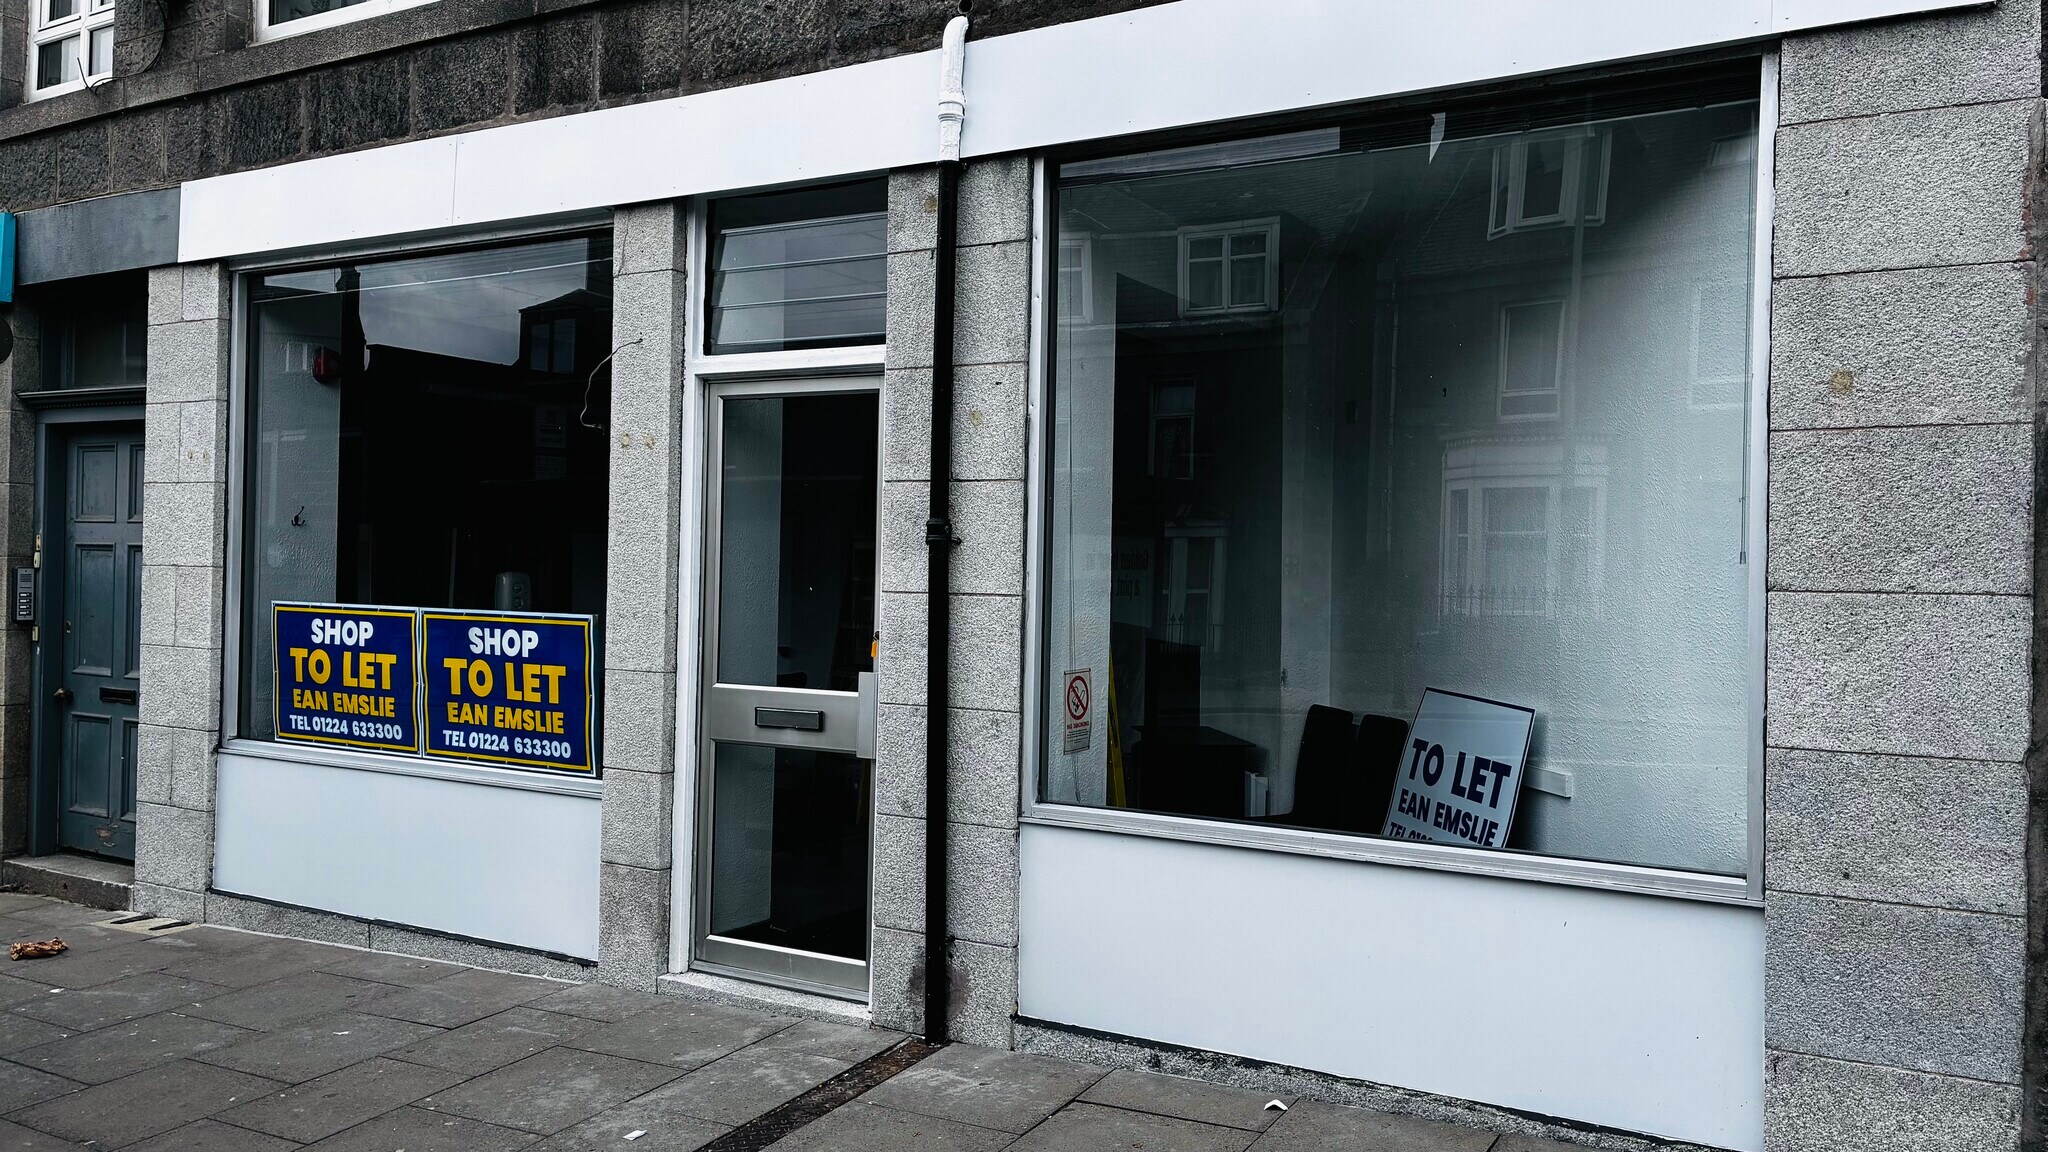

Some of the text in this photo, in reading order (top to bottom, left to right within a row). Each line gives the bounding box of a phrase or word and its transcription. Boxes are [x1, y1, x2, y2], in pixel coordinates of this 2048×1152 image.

[311, 618, 374, 647] SHOP
[468, 627, 539, 658] SHOP
[290, 647, 397, 690] TO LET
[443, 657, 566, 704] TO LET
[293, 688, 395, 718] EAN EMSLIE
[447, 702, 564, 734] EAN EMSLIE
[289, 714, 403, 740] TEL 01224 633300
[443, 729, 572, 759] TEL 01224 633300
[1409, 737, 1512, 810] TO LET
[1397, 788, 1499, 847] EAN EMSLIE
